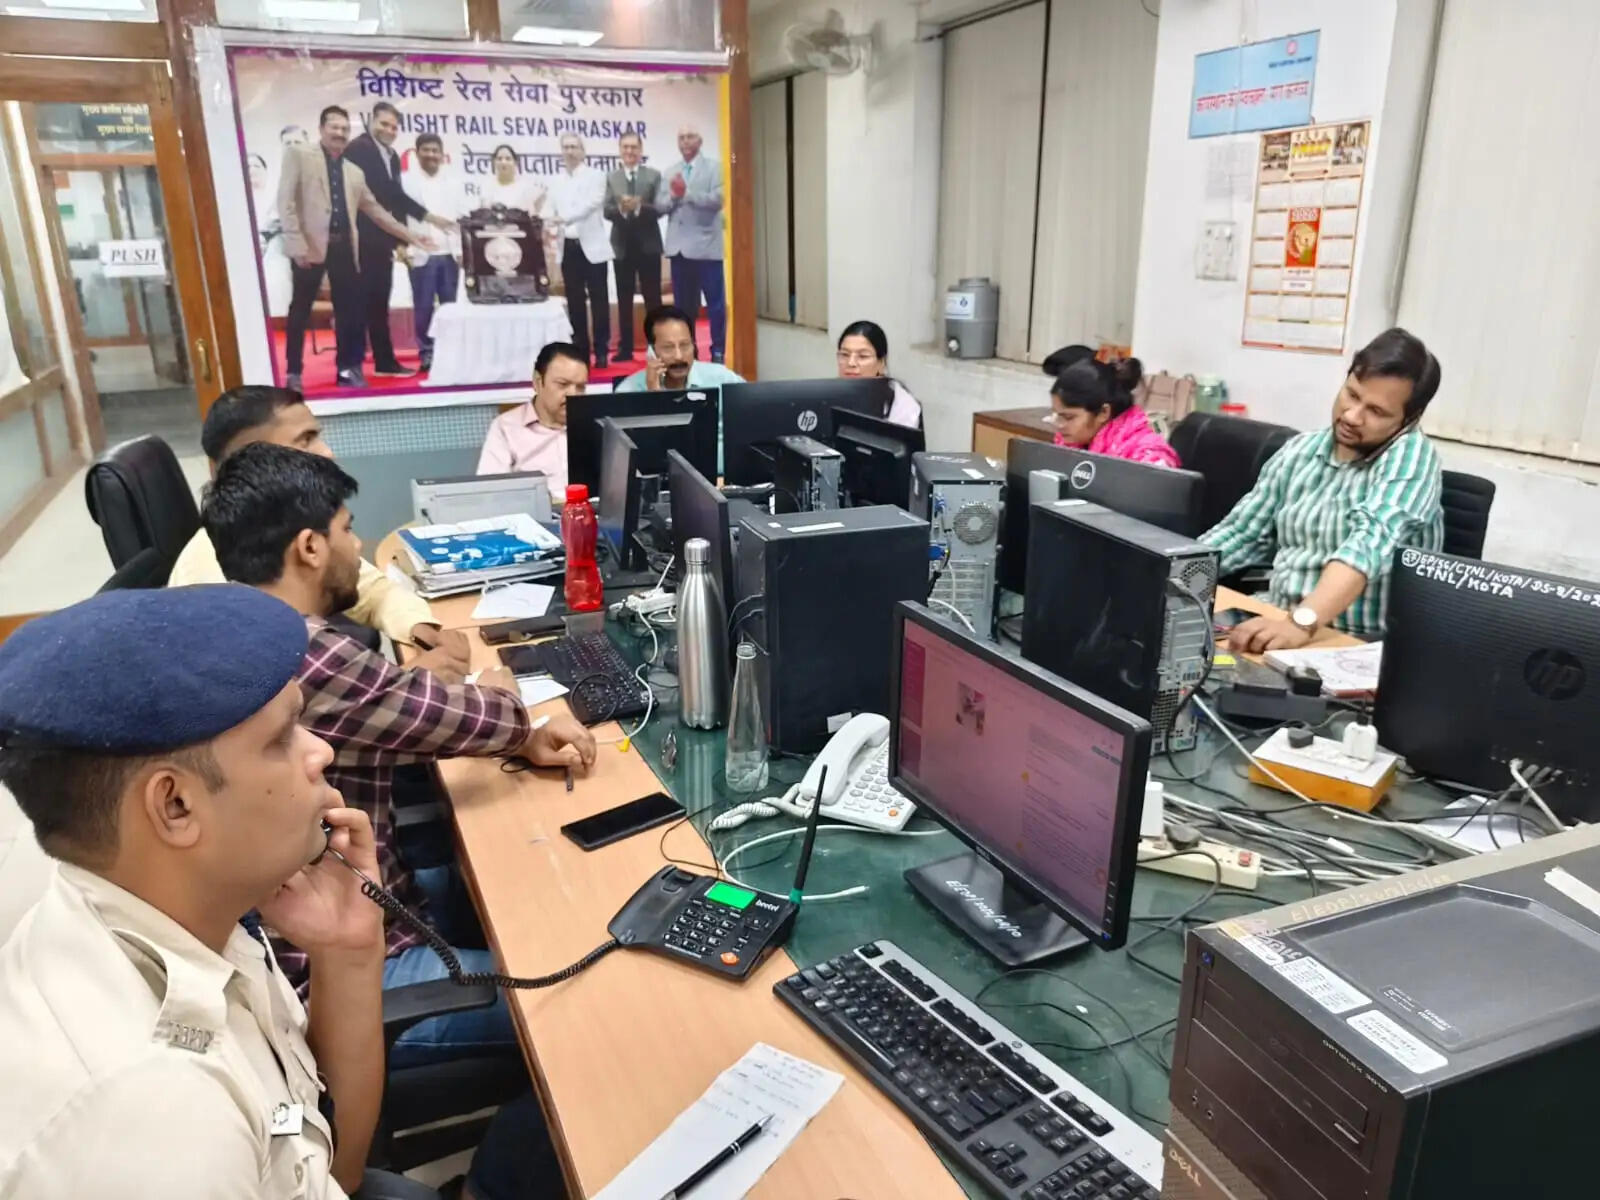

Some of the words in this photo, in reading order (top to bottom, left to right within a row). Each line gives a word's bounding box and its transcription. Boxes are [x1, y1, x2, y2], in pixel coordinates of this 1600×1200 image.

[356, 67, 444, 98] विशिष्ट
[453, 72, 492, 101] रेल
[500, 74, 548, 103] सेवा
[558, 84, 643, 113] पुरस्कार
[360, 112, 448, 133] VISHT
[456, 115, 498, 135] RAIL
[503, 117, 548, 136] SEVA
[554, 118, 647, 138] PURASKAR
[462, 143, 496, 175] रेल
[111, 248, 157, 263] PUSH
[799, 411, 816, 431] hp
[1416, 564, 1513, 598] CTNL/KOTA
[1169, 1147, 1201, 1188] DELL
